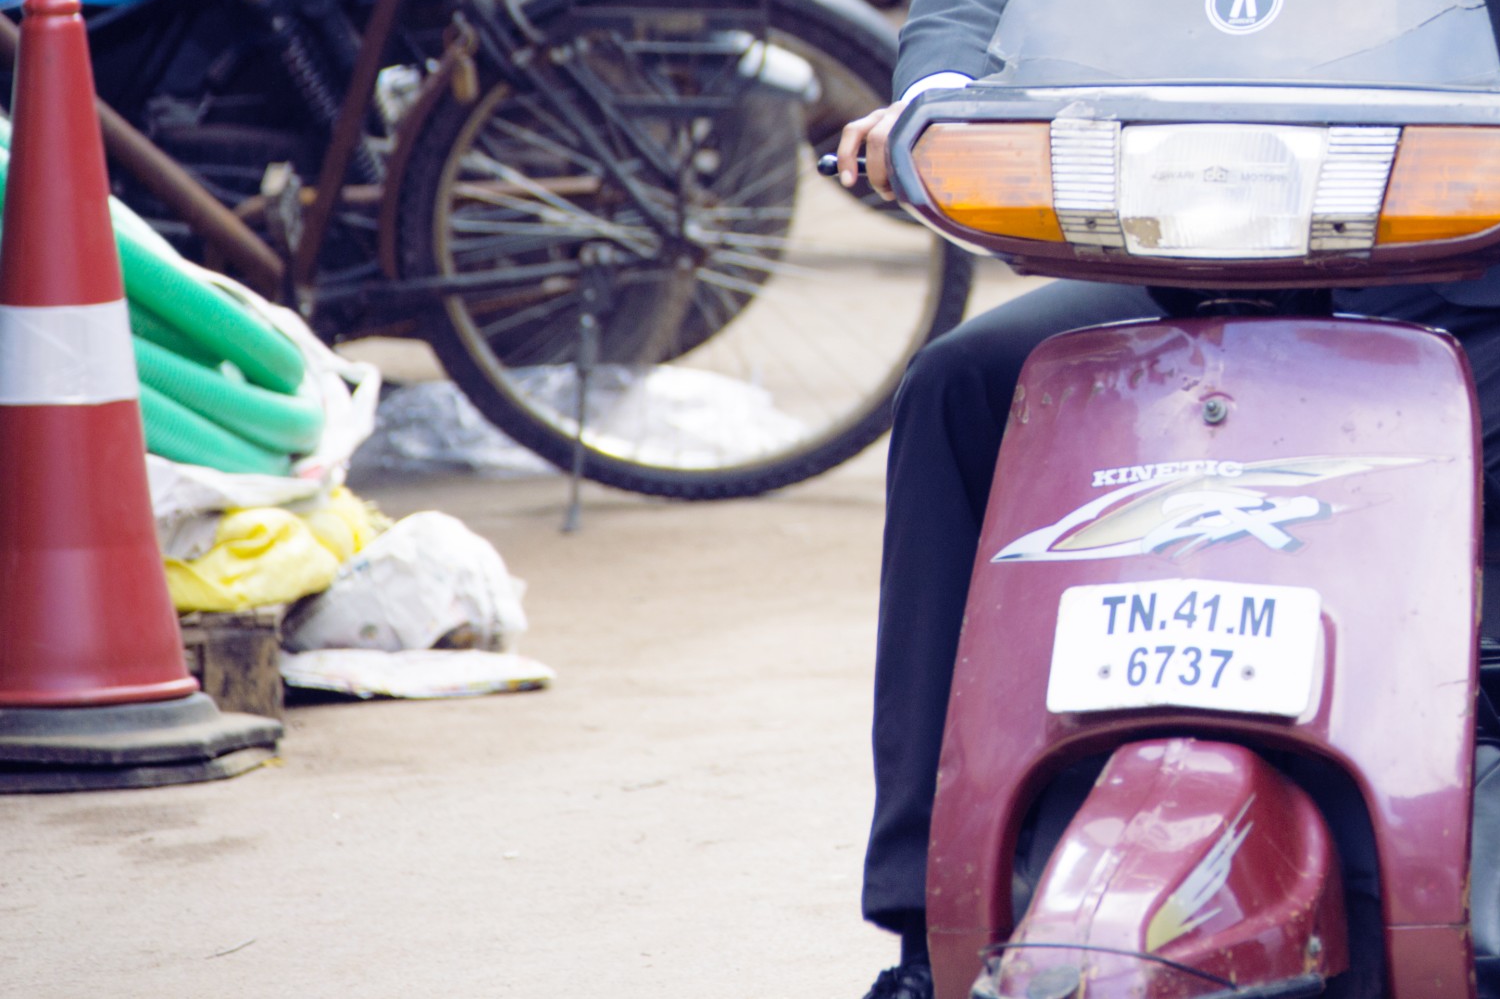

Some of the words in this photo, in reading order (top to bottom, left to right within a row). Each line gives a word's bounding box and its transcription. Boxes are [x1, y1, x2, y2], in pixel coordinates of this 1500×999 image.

[1091, 460, 1243, 487] KINETIC
[1102, 590, 1276, 637] TN.41.M
[1126, 645, 1234, 688] 6737
